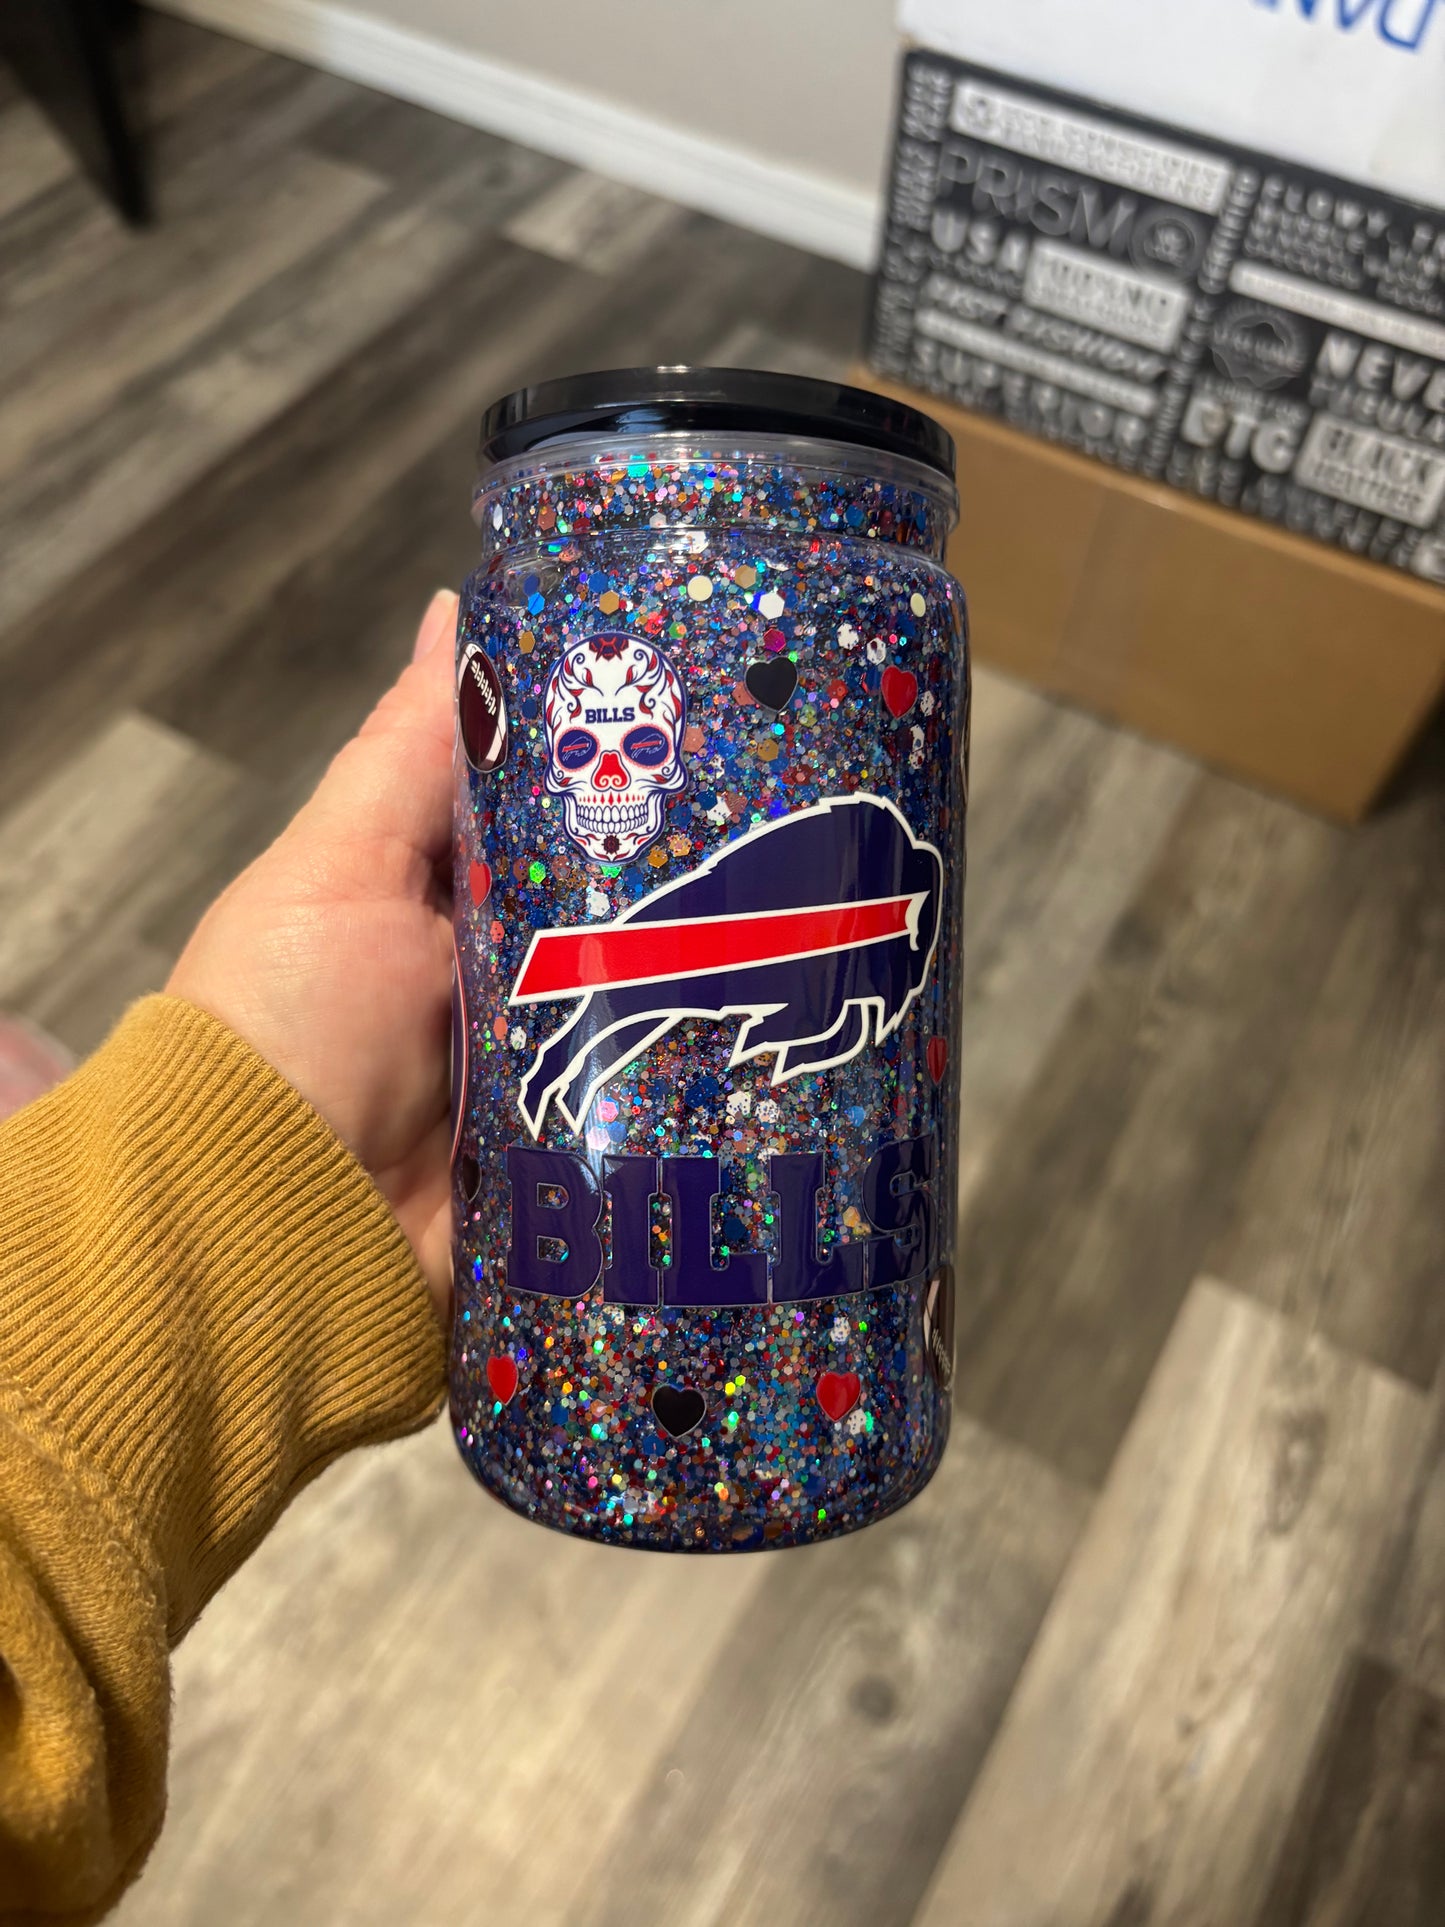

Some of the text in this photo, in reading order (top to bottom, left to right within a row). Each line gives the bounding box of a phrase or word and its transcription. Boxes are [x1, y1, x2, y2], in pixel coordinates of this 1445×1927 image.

[931, 208, 1029, 274] USA
[937, 138, 1137, 257] PRISM
[585, 707, 635, 724] BILLS
[506, 1134, 937, 1308] BILLS
